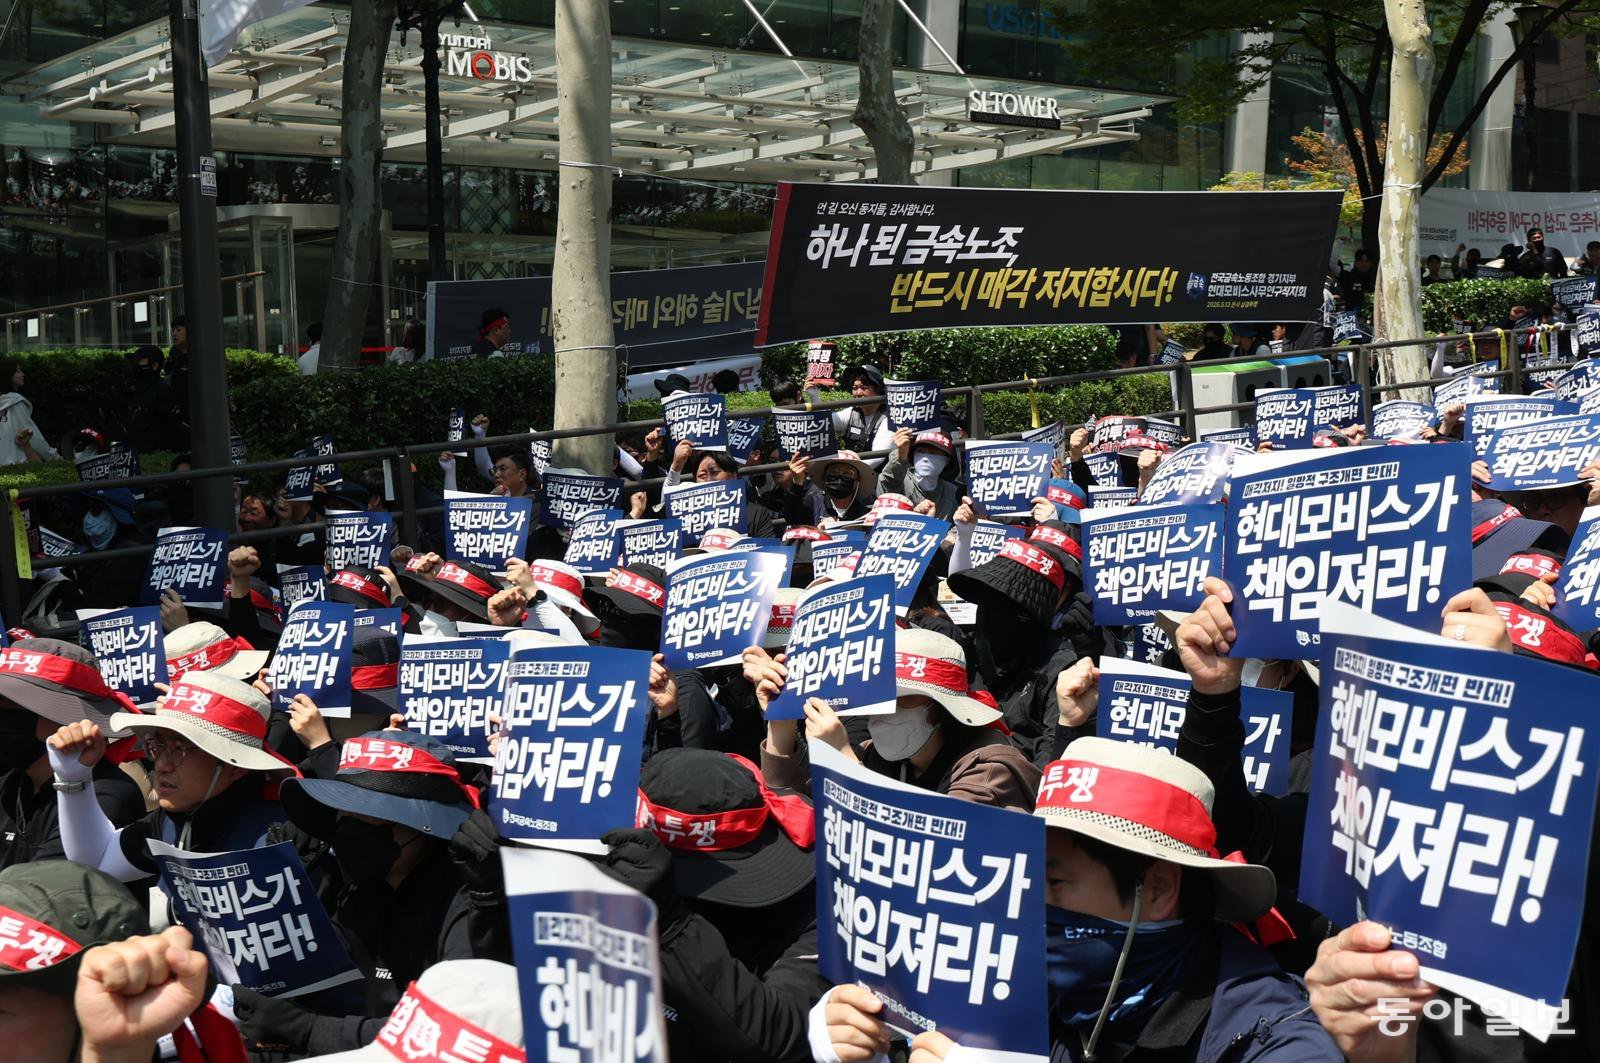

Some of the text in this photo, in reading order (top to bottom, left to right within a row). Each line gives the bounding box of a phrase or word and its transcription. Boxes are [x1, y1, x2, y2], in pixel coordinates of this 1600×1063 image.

[438, 33, 492, 50] YUNDAI
[447, 50, 532, 82] MOBIS
[829, 202, 838, 215] 길
[838, 202, 858, 215] 오신
[858, 202, 888, 217] 동지들,
[889, 203, 935, 216] 감사합니다.
[807, 223, 870, 269] 하나
[869, 224, 907, 266] 된
[890, 267, 1179, 313] 반드시 매각 저지합시다!
[1207, 285, 1307, 298] 현대모비스사무연구직지회
[1211, 272, 1297, 284] 전국금속노동조합 경기지부
[887, 388, 938, 406] 현대모비스가
[665, 403, 723, 425] 현대모비스가
[775, 419, 831, 435] 현대모비스가
[889, 404, 935, 424] 책임져라!
[670, 420, 720, 441] 책임져라!
[780, 434, 830, 453] 책임져라!
[970, 453, 1048, 478] 현대모비스가
[1493, 444, 1598, 478] 책임져라!
[546, 481, 620, 502] 현대모비스가
[971, 475, 1042, 502] 책임져라!
[1244, 462, 1397, 497] 매각저지! 일방적 구조개편 반대!
[671, 488, 743, 516] 현대모비스가
[1237, 475, 1459, 555] 현대모비스가
[449, 509, 526, 532] 현대모비스가
[681, 507, 740, 534] 책임져라!
[1167, 513, 1187, 524] 반대!
[152, 541, 223, 566] 현대모비스가
[454, 532, 519, 559] 책임져라!
[624, 530, 680, 555] 현대모비스가
[1089, 521, 1217, 567] 현대모비스가
[1023, 549, 1054, 575] 투쟁
[150, 563, 217, 590] 책임져라!
[665, 555, 787, 615] 현대모비스가
[1094, 556, 1210, 605] 책임져라!
[1242, 540, 1447, 623] 책임져라!
[665, 600, 761, 650] 책임져라!
[777, 605, 796, 625] 투
[788, 594, 891, 655] 현대모비스가
[90, 622, 158, 657] 현대모비스가
[5, 651, 42, 673] 투쟁
[177, 650, 211, 673] 투쟁
[528, 661, 588, 677] 구조개편 반대!
[786, 635, 884, 696] 책임져라!
[400, 659, 511, 694] 현대모비스가
[1366, 661, 1396, 684] 일방적
[1396, 666, 1457, 694] 구조개편
[1462, 678, 1511, 705] 반대!
[171, 687, 213, 713] 투쟁
[1115, 681, 1177, 700] 매각저지! 일방적
[404, 696, 503, 737] 책임져라!
[363, 740, 414, 769] 투쟁
[1329, 680, 1585, 817] 현대모비스가
[1046, 765, 1100, 803] 투쟁
[661, 815, 716, 847] 투쟁
[852, 796, 877, 816] 일방적
[881, 802, 926, 832] 구조개편
[930, 817, 965, 839] 반대!
[823, 805, 1031, 919] 현대모비스가
[1330, 771, 1560, 928] 책임져라!
[228, 862, 250, 878] 반대!
[0, 916, 67, 970] 투쟁
[833, 877, 1019, 1005] 책임져라!
[1388, 926, 1448, 960] 노동조합
